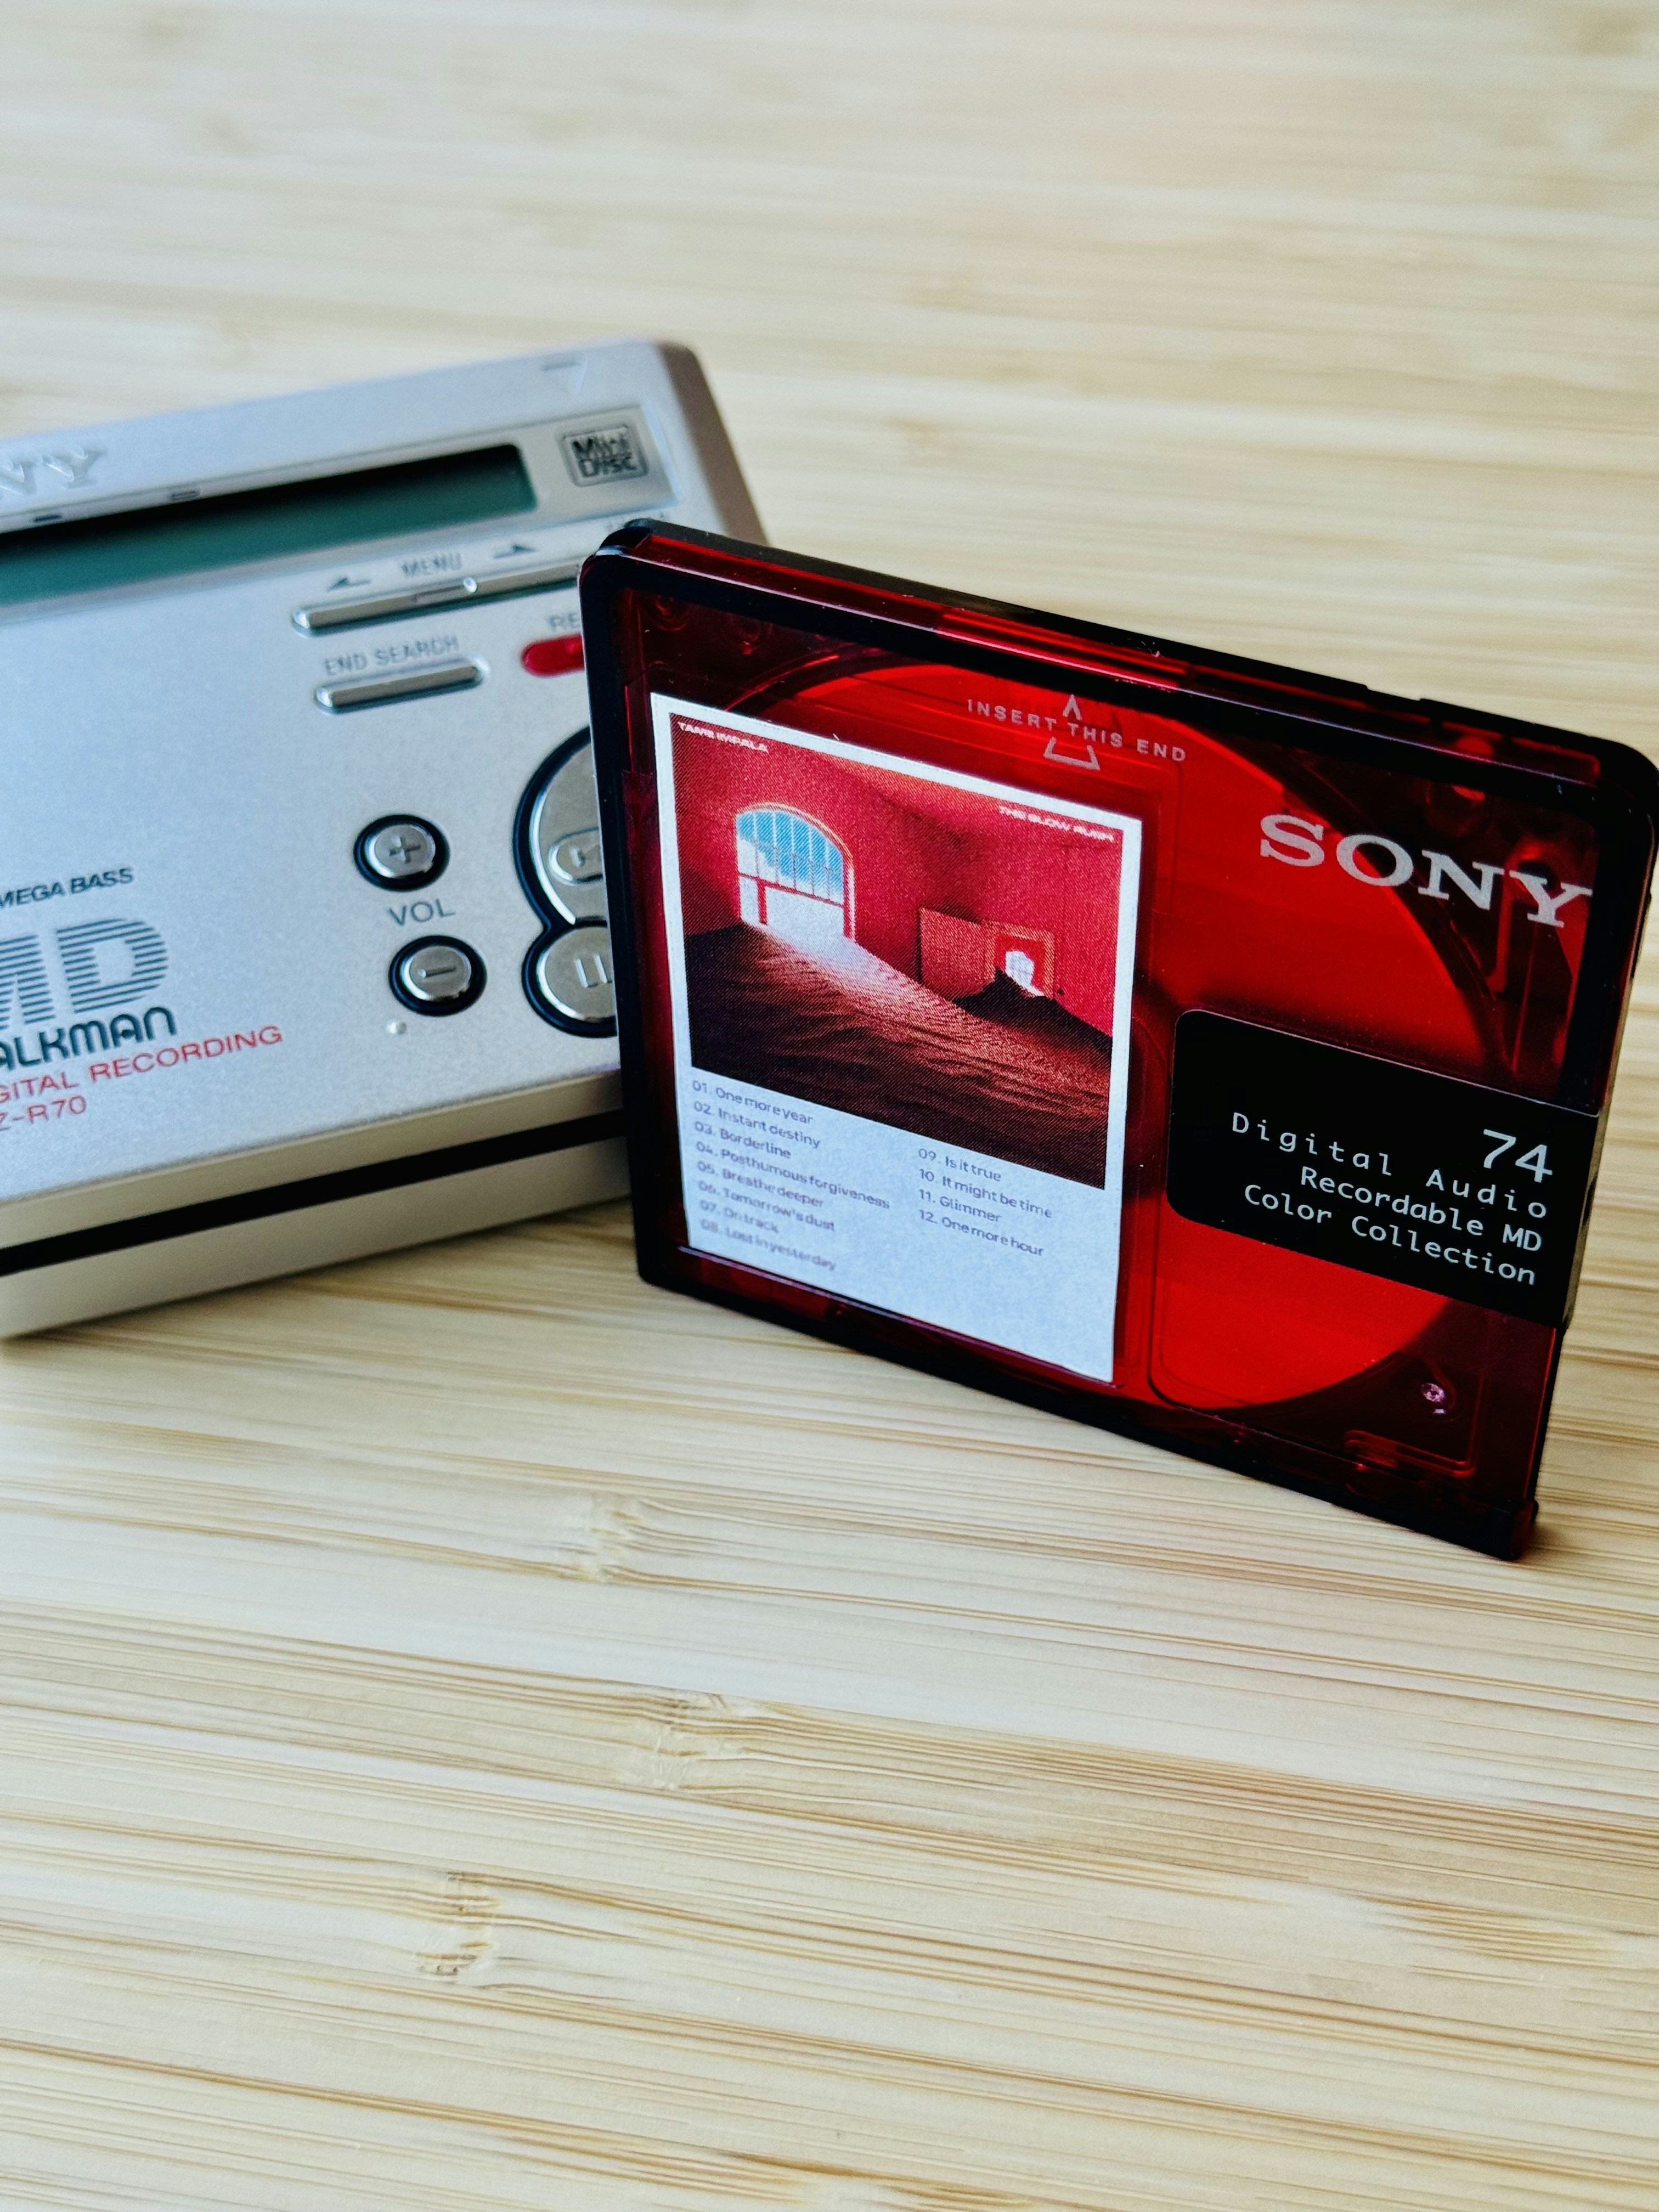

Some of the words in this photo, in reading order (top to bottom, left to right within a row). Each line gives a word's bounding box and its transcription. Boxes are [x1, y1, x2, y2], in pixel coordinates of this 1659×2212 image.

[401, 552, 462, 576] MENU
[325, 650, 368, 676] END
[375, 635, 460, 666] SEARCH
[967, 699, 1057, 731] INSERT
[1068, 722, 1123, 748] THIS
[1136, 738, 1186, 761] END
[70, 867, 134, 894] BASS
[1260, 814, 1593, 928] SONY
[387, 899, 455, 927] VOL
[89, 1024, 284, 1083] RECORDING
[716, 1087, 742, 1104] One
[781, 1108, 813, 1125] year
[718, 1107, 767, 1132] Instant
[769, 1124, 821, 1149] destiny
[720, 1127, 791, 1159] Borderline
[945, 1155, 957, 1167] Is
[960, 1159, 969, 1172] it
[971, 1164, 1002, 1182] true
[1231, 1111, 1392, 1176] Digital
[1425, 1169, 1547, 1219] Audio
[1482, 1128, 1553, 1183] 74
[721, 1148, 808, 1183] Posthumous
[809, 1175, 890, 1209] forgiveness
[777, 1187, 823, 1207] deeper
[942, 1176, 952, 1188] It
[955, 1182, 997, 1201] might
[1000, 1193, 1017, 1207] be
[1019, 1199, 1052, 1218] time
[939, 1196, 1002, 1222] Glimmer
[1301, 1166, 1483, 1236] Recordable
[1502, 1223, 1542, 1251] MD
[941, 1216, 969, 1234] One
[972, 1227, 1008, 1245] more
[1011, 1237, 1045, 1256] hour
[1244, 1184, 1332, 1223] Color
[1351, 1216, 1535, 1285] Collection
